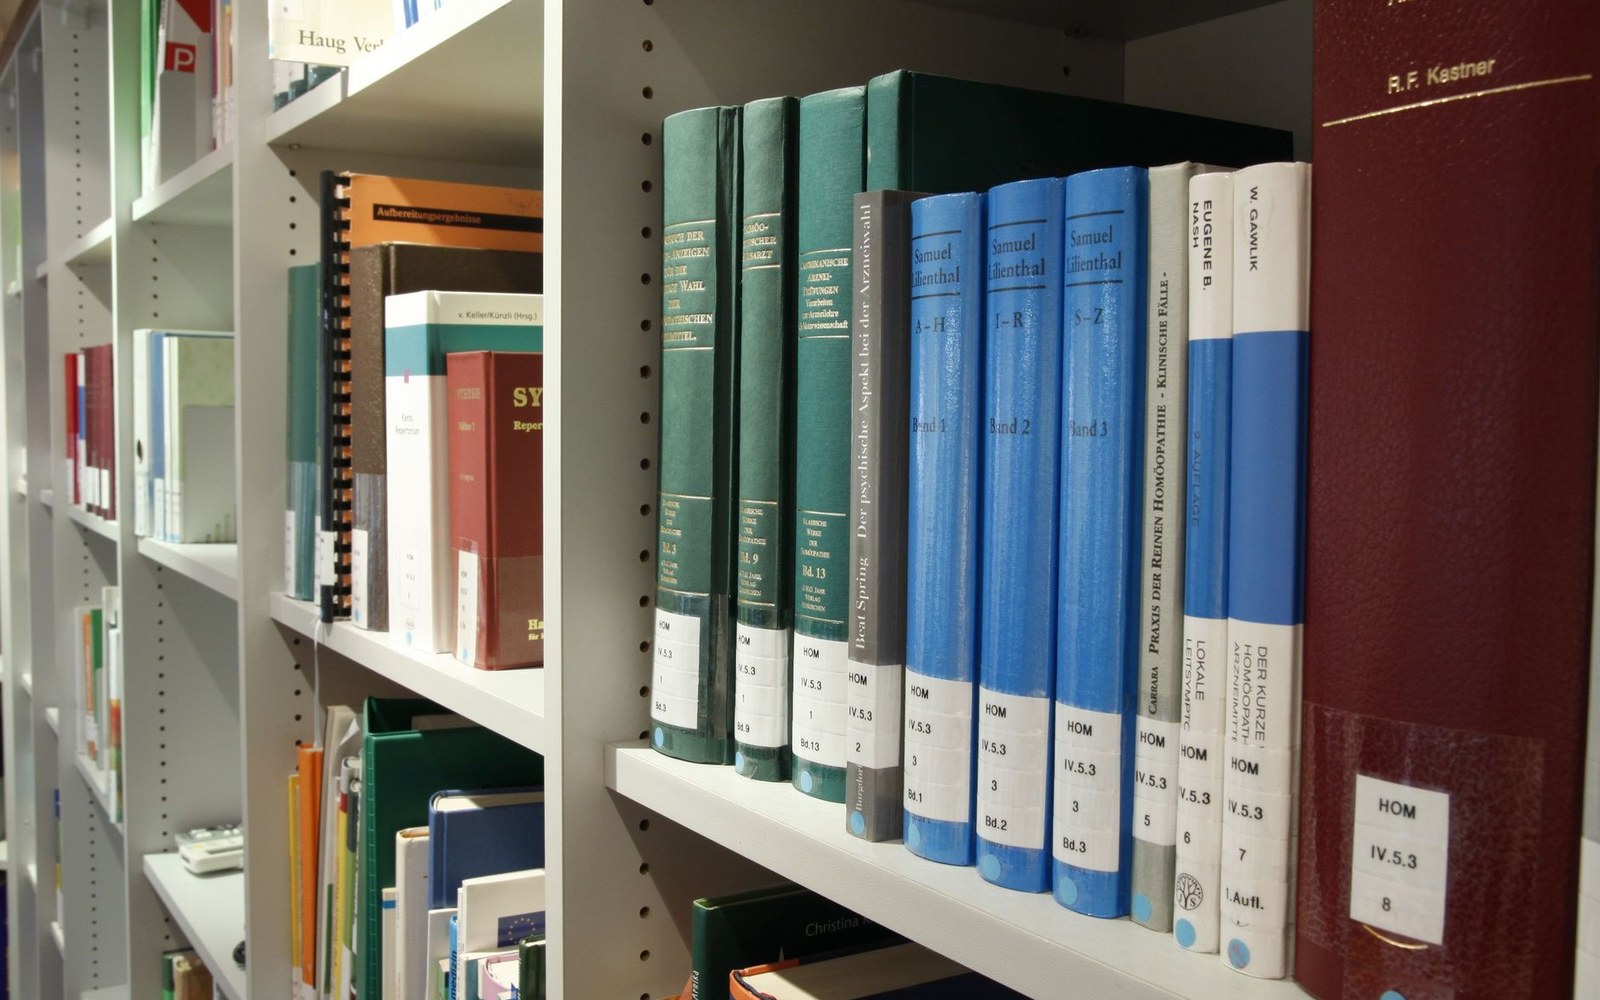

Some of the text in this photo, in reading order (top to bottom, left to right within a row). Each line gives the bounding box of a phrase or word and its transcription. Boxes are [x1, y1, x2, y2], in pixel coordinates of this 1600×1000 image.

[299, 29, 383, 53] Haug Ver
[174, 47, 194, 71] P
[1388, 59, 1496, 93] R.F. Kastner
[377, 206, 482, 224] Aufbereitungsergebnisse
[1071, 224, 1113, 247] Samuel
[1249, 186, 1258, 271] W. GAWLIK
[992, 233, 1036, 255] Samuel
[1203, 200, 1212, 291] EUGENE B.
[915, 242, 952, 264] Samuel
[989, 258, 1046, 281] Lilienthal
[1067, 251, 1122, 275] Lilienthal
[680, 280, 705, 292] WAHL
[1158, 279, 1168, 316] FÄLLE
[466, 311, 513, 320] Keller/Künzli
[514, 311, 538, 321] (Hrsg.)
[1157, 321, 1168, 389] KLINISCHE
[513, 387, 543, 407] SY
[855, 204, 872, 650] Beat Spring Der psychische Aspekt bei der Arzneiwahl
[940, 418, 946, 433] 1
[990, 418, 1031, 435] Band 2
[1069, 420, 1108, 437] Band 3
[1153, 404, 1166, 511] HOMÖOPATHIE
[1152, 516, 1163, 569] REINEN
[752, 553, 759, 564] 9
[802, 565, 826, 579] Bd. 13
[1152, 574, 1162, 601] DER
[659, 620, 670, 630] HOM
[1149, 605, 1161, 654] PRAXIS
[738, 634, 750, 646] HOM
[803, 647, 819, 659] HOM
[849, 672, 868, 686] HOM
[1195, 640, 1205, 701] LOKALE
[801, 677, 822, 691] IV.5.3
[910, 685, 929, 700] HOM
[1148, 666, 1158, 714] CARRARA
[1255, 646, 1268, 742] DER KURZE
[656, 701, 667, 712] Bd.3
[849, 705, 873, 721] IV.5.3
[985, 703, 1007, 718] HOM
[737, 721, 750, 733] Bd.9
[908, 718, 931, 735] IV.5.3
[1067, 720, 1093, 736] HOM
[800, 738, 820, 752] Bd.13
[855, 742, 861, 753] 2
[981, 739, 1006, 756] IV.5.3
[1140, 731, 1165, 748] HOM
[912, 756, 917, 766] 3
[1181, 744, 1207, 761] HOM
[1064, 759, 1097, 776] IV.5.3
[1232, 757, 1259, 775] HOM
[991, 780, 997, 791] 3
[1135, 771, 1167, 789] IV.5.3
[908, 788, 922, 803] Bd.1
[1072, 801, 1079, 812] 3
[1229, 799, 1263, 820] IV.5.3
[1379, 798, 1416, 819] HOM
[985, 815, 1007, 831] Bd.2
[1144, 815, 1150, 826] 5
[1063, 837, 1086, 853] Bd.3
[1184, 831, 1190, 843] 6
[1239, 848, 1246, 861] 7
[1371, 845, 1417, 869] IV.5.3
[1226, 887, 1265, 910] 1.Aufl.
[1382, 897, 1391, 911] 8
[805, 918, 858, 937] Christina
